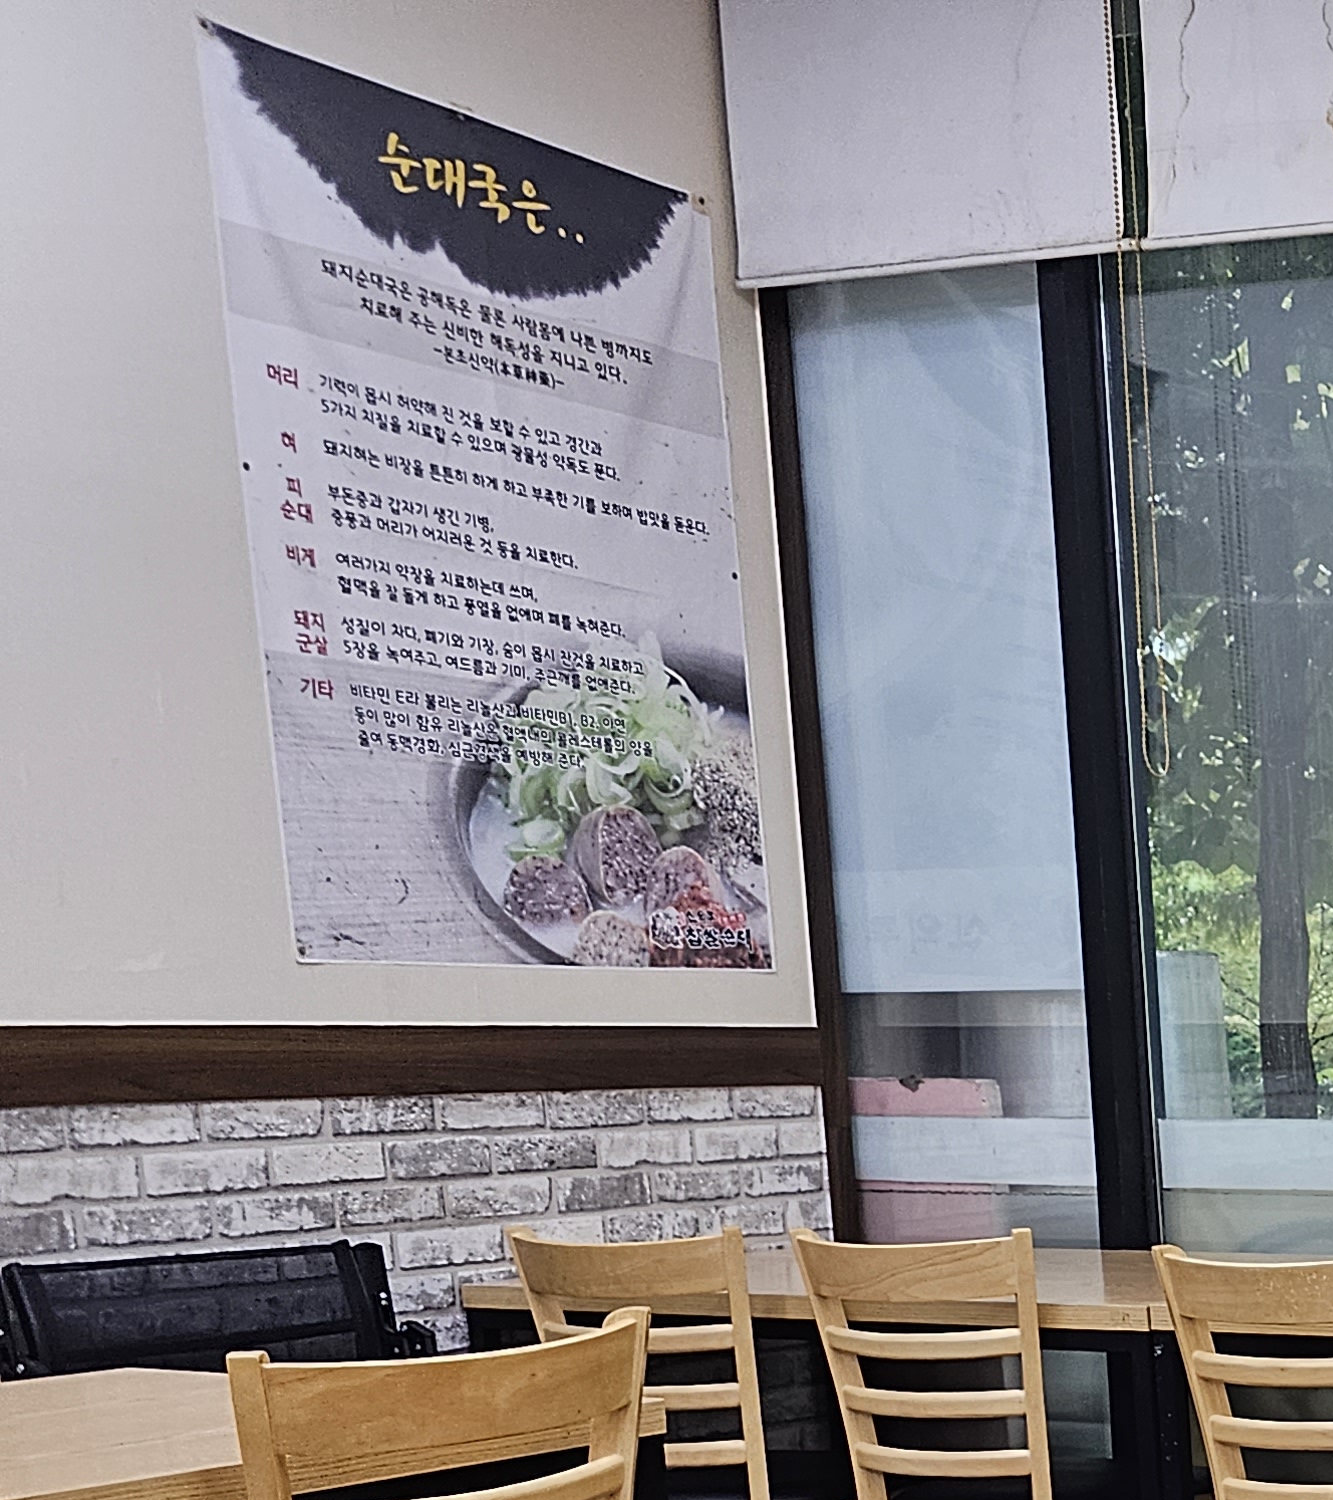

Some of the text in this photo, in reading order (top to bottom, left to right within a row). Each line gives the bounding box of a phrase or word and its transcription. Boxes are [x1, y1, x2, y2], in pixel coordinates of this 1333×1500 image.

[321, 259, 653, 366] 돼지순대국은 공해독은 물론 사람몸에 나쁜 병까지도
[360, 297, 629, 386] 치료해 주는 신비한 해독성을 지니고 있다.
[266, 363, 299, 390] 머리
[319, 374, 360, 398] 기력이
[365, 386, 392, 406] 몹시
[396, 394, 438, 418] 허약해
[441, 404, 454, 425] 진
[459, 408, 484, 432] 것을
[518, 424, 532, 441] 수
[534, 427, 562, 447] 있고
[565, 434, 603, 457] 경간과
[280, 430, 298, 454] 혀
[320, 398, 357, 421] 5가지
[407, 419, 447, 446] 치료할
[451, 431, 464, 448] 수
[467, 433, 508, 456] 있으며
[511, 442, 549, 469] 광물성
[552, 453, 591, 476] 약독도
[285, 476, 303, 499] 피
[323, 439, 381, 469] 돼지혀는
[384, 453, 425, 479] 비장을
[429, 462, 469, 486] 튼튼히
[471, 472, 499, 492] 하게
[503, 478, 529, 499] 하고
[531, 485, 569, 510] 부족한
[572, 494, 597, 516] 기를
[600, 499, 634, 521] 보하여
[636, 507, 671, 531] 밥맛을
[280, 499, 315, 525] 순대
[387, 496, 429, 519] 갑자기
[433, 506, 461, 528] 생긴
[464, 512, 495, 534] 기병.
[331, 508, 579, 570] 중풍과 머리가 어지러운 것 등을 치료한다.
[335, 552, 391, 576] 여러가지
[336, 575, 381, 600] 혈맥을
[385, 583, 400, 604] 잘
[433, 592, 460, 611] 하고
[463, 597, 502, 621] 풍열을
[293, 609, 326, 634] 돼지
[295, 632, 329, 657] 군살
[341, 615, 387, 638] 성질이
[502, 640, 528, 660] 숨이
[531, 645, 557, 664] 몹시
[599, 655, 646, 677] 치료하고
[343, 639, 380, 662] 5장을
[445, 655, 498, 678] 여드름과
[534, 667, 582, 691] 주근깨를
[300, 677, 335, 701] 기타
[349, 683, 391, 706] 비타민
[424, 692, 463, 716] 불리는
[354, 705, 380, 726] 등이
[383, 709, 411, 729] 많이
[416, 713, 444, 734] 함유
[556, 731, 627, 755] 콜레스테롤의
